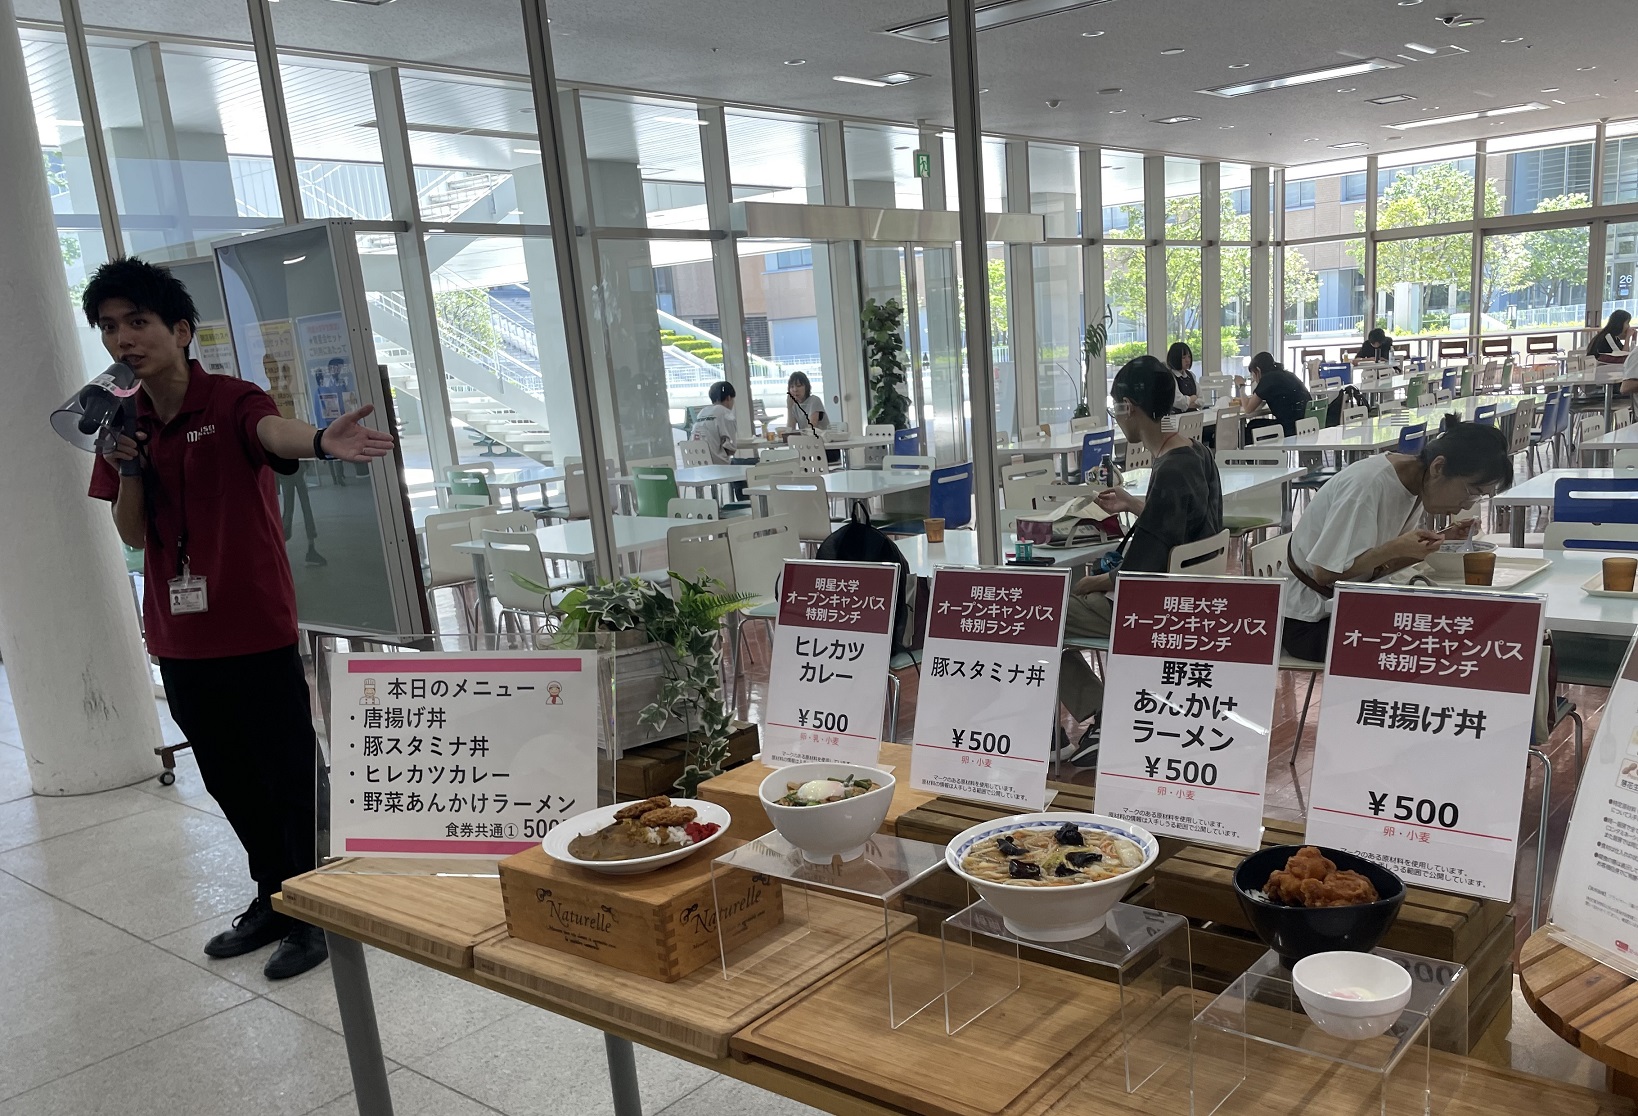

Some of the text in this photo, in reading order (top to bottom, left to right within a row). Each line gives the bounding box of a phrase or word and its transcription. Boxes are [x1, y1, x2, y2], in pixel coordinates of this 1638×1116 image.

[1619, 274, 1633, 284] 26
[814, 577, 860, 593] 明星大学
[970, 585, 1024, 602] 明星大学
[786, 590, 886, 611] オープンキャンパス
[937, 600, 1055, 622] オープンキャンパス
[1163, 596, 1229, 615] 明星大学
[805, 607, 862, 624] 特別ランチ
[960, 618, 1026, 636] 特別ランチ
[1122, 612, 1268, 636] オープンキャンパス
[1393, 612, 1475, 635] 明星大学
[796, 635, 865, 662] ヒレカツ
[1151, 633, 1232, 652] 特別ランチ
[1342, 629, 1525, 661] オープンキャンパス
[798, 661, 854, 684] カレー
[930, 656, 1046, 688] 豚スタミナ丼
[1160, 660, 1214, 689] 野菜
[1378, 652, 1480, 678] 特別ランチ
[387, 677, 535, 700] 本日のメニュー
[1133, 688, 1238, 722] あんかけ
[798, 708, 849, 732] ¥500
[1356, 698, 1488, 740] 唐揚げ丼
[951, 728, 1012, 755] ¥500
[1132, 719, 1235, 751] ラーメン
[961, 755, 993, 769] 卵・小麦
[1144, 755, 1218, 786] ¥500
[1157, 786, 1196, 801] 卵・小麦
[1122, 807, 1225, 829] マークのある原材料を使用しています。
[1367, 790, 1460, 829] ¥500
[445, 821, 519, 840] 食券共通①
[1383, 825, 1431, 844] 卵・小麦
[546, 899, 612, 934] Naturelle
